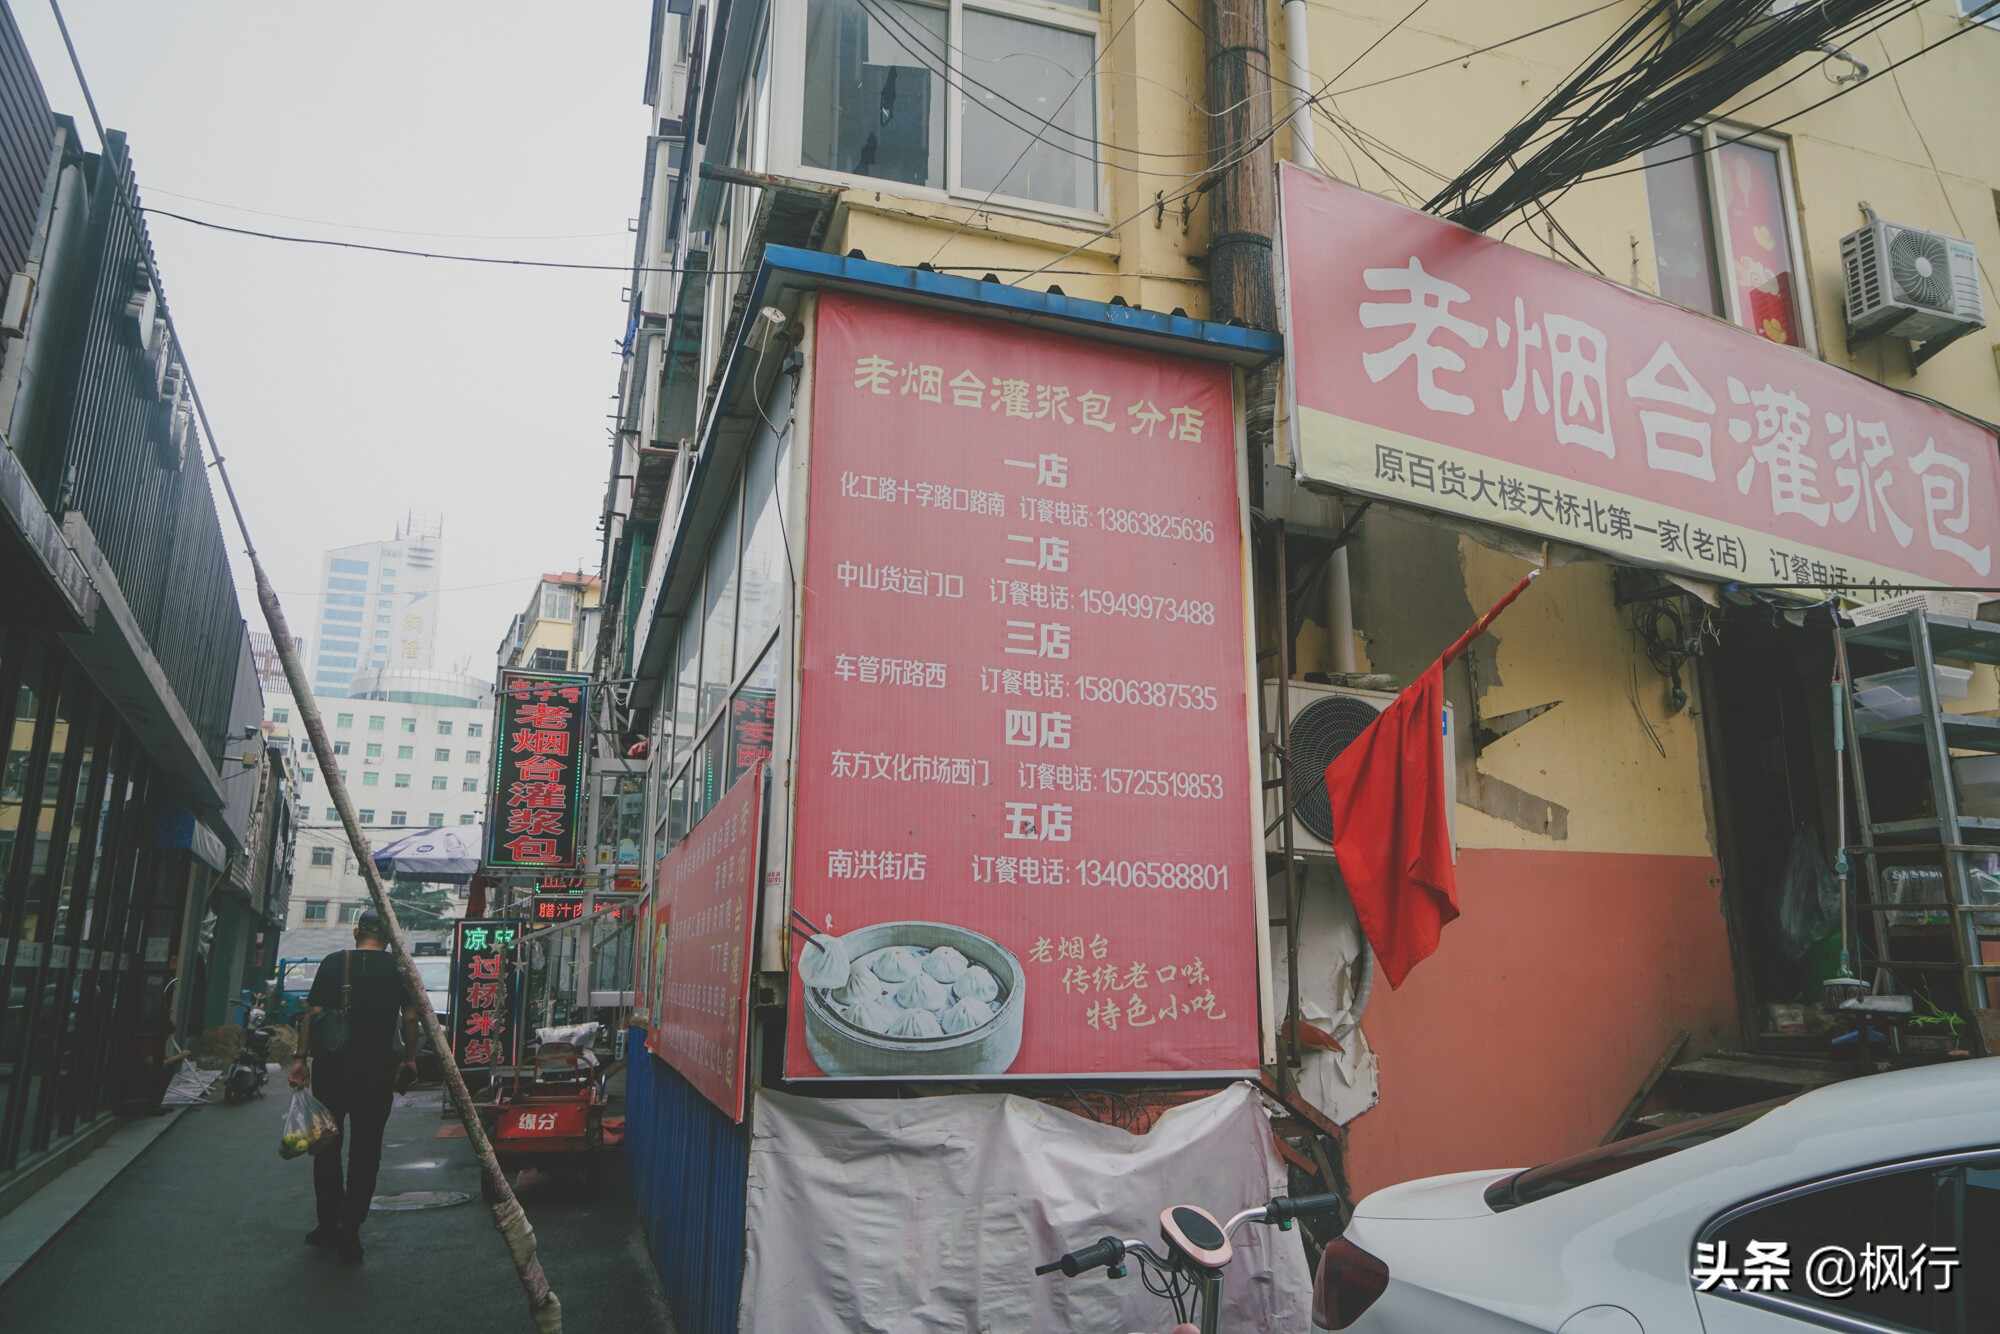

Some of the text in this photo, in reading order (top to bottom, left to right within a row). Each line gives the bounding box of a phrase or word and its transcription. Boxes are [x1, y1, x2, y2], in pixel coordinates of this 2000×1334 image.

[853, 354, 1206, 443] 老烟台灌浆包 分店
[1356, 254, 1992, 578] 老烟台灌浆包
[1003, 453, 1069, 489] 一店
[839, 471, 1006, 519] 化工路十字路口路南
[1373, 442, 1748, 575] 原百货大楼天桥北第一家(老店)
[1004, 534, 1070, 573] 二店
[836, 560, 965, 599] 中山货运门口
[1004, 620, 1071, 660] 三店
[833, 653, 948, 690] 车管所路西
[1004, 708, 1073, 750] 四店
[503, 702, 573, 864] 老烟台灌浆包
[830, 750, 990, 787] 东方文化市场西门
[1003, 801, 1074, 843] 五店
[827, 849, 928, 882] 南洪街店
[1028, 933, 1112, 964] 老烟台
[1061, 956, 1212, 996] 传统老口味
[1085, 989, 1228, 1032] 特色小吃
